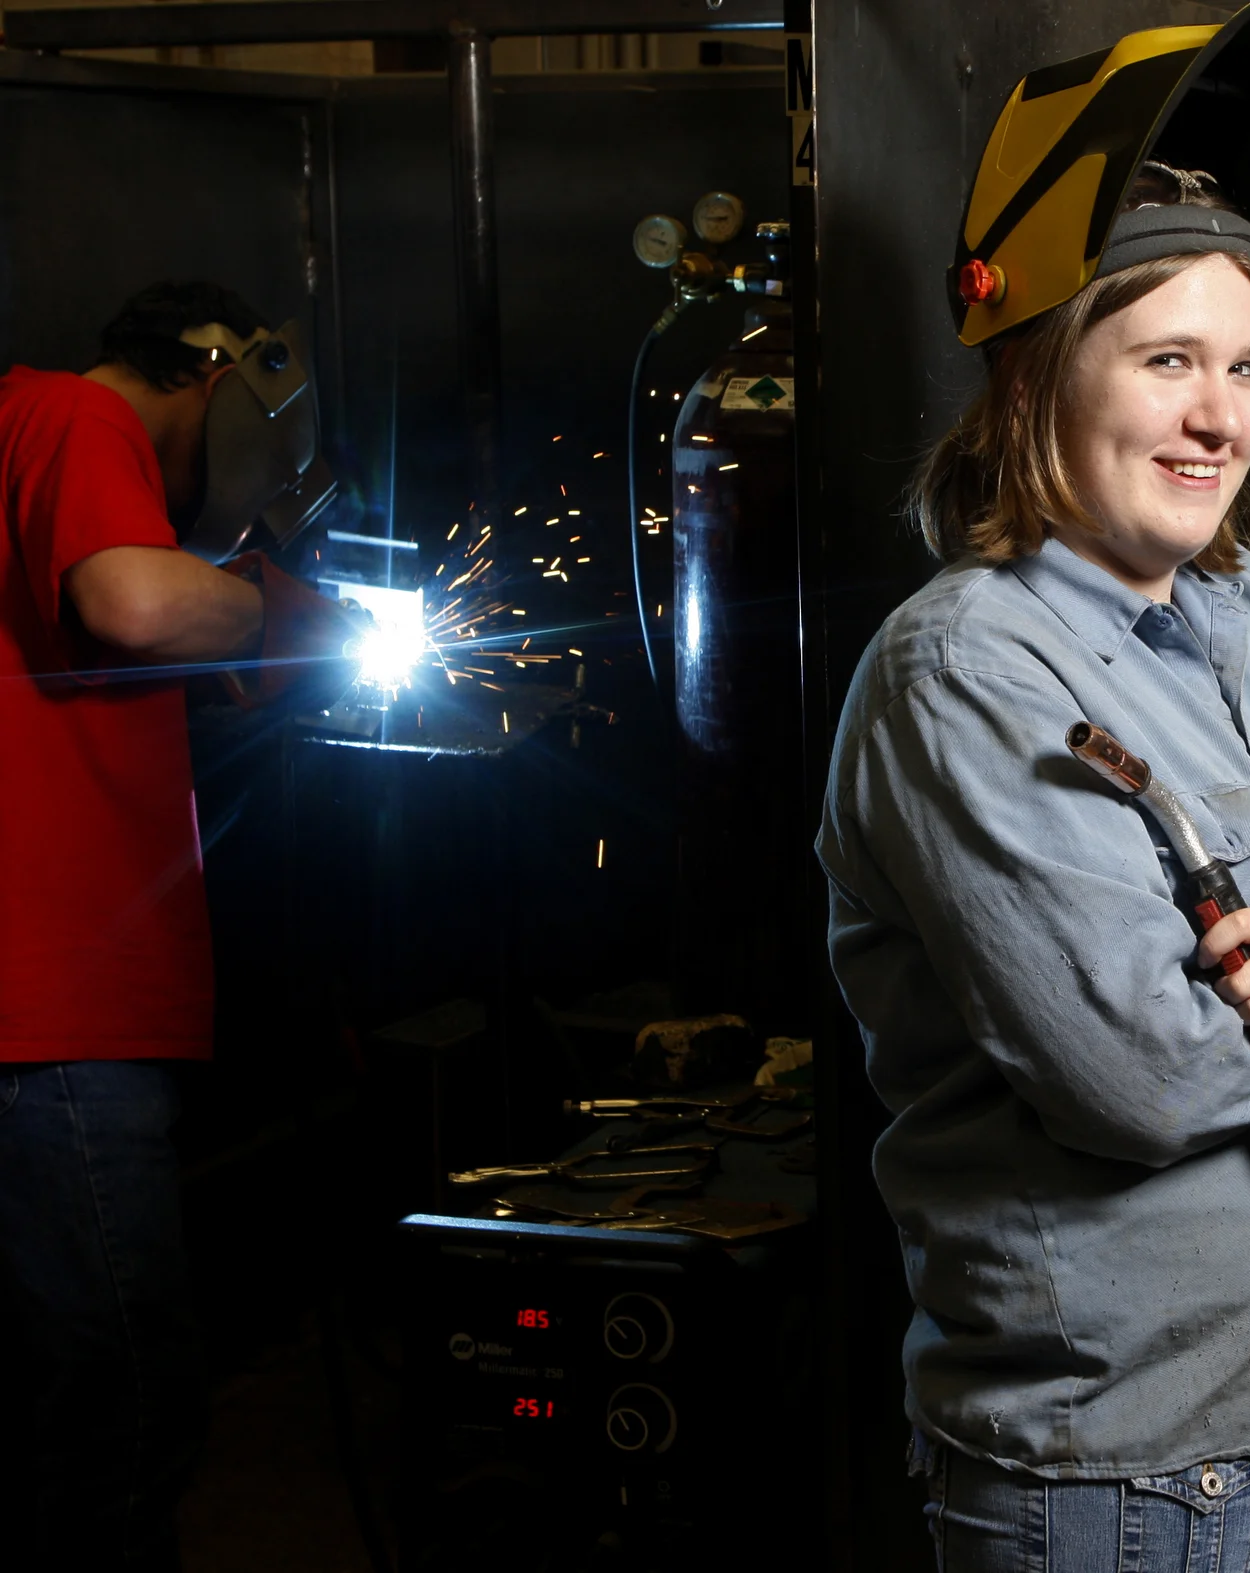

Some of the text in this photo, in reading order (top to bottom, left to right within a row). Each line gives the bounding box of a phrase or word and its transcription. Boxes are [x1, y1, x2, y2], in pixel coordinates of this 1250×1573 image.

[796, 121, 814, 181] 4
[477, 1342, 514, 1356] Miller
[513, 1397, 554, 1418] 251
